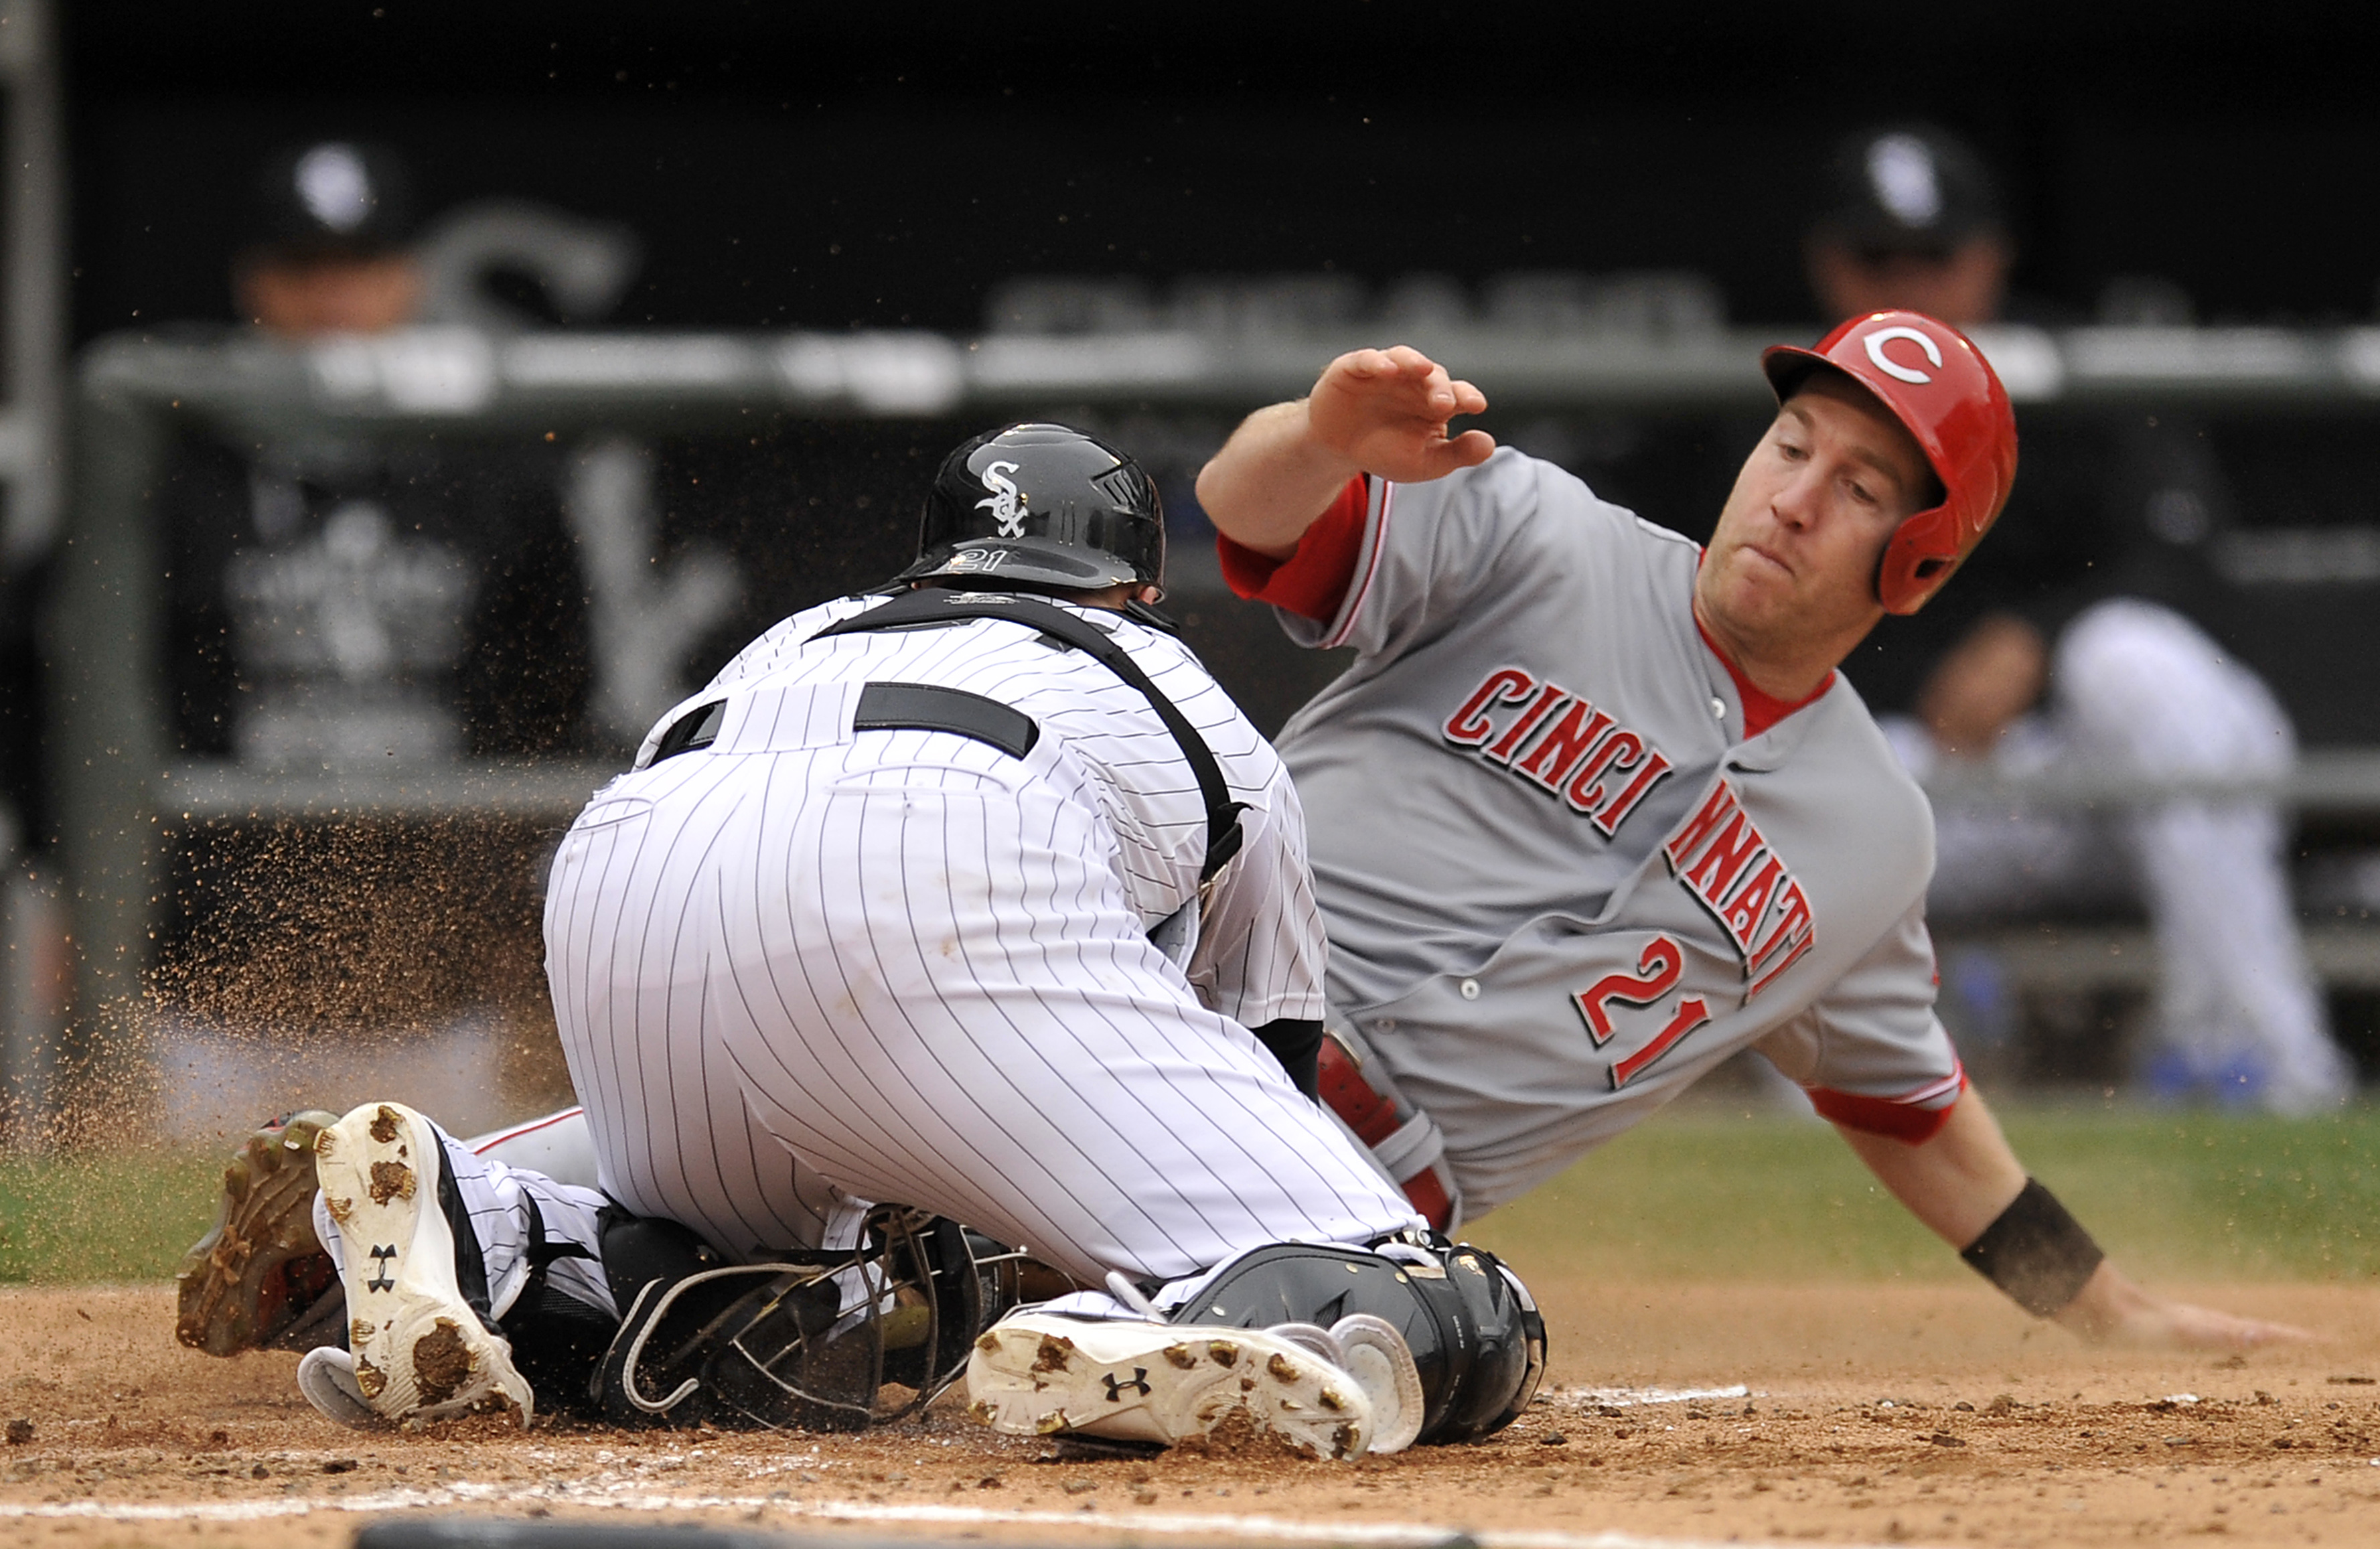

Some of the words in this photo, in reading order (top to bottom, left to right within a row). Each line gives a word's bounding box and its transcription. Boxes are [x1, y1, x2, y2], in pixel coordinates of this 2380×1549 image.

[1863, 326, 1943, 384] C
[947, 548, 1008, 572] 21
[1572, 932, 1712, 1089] 21
